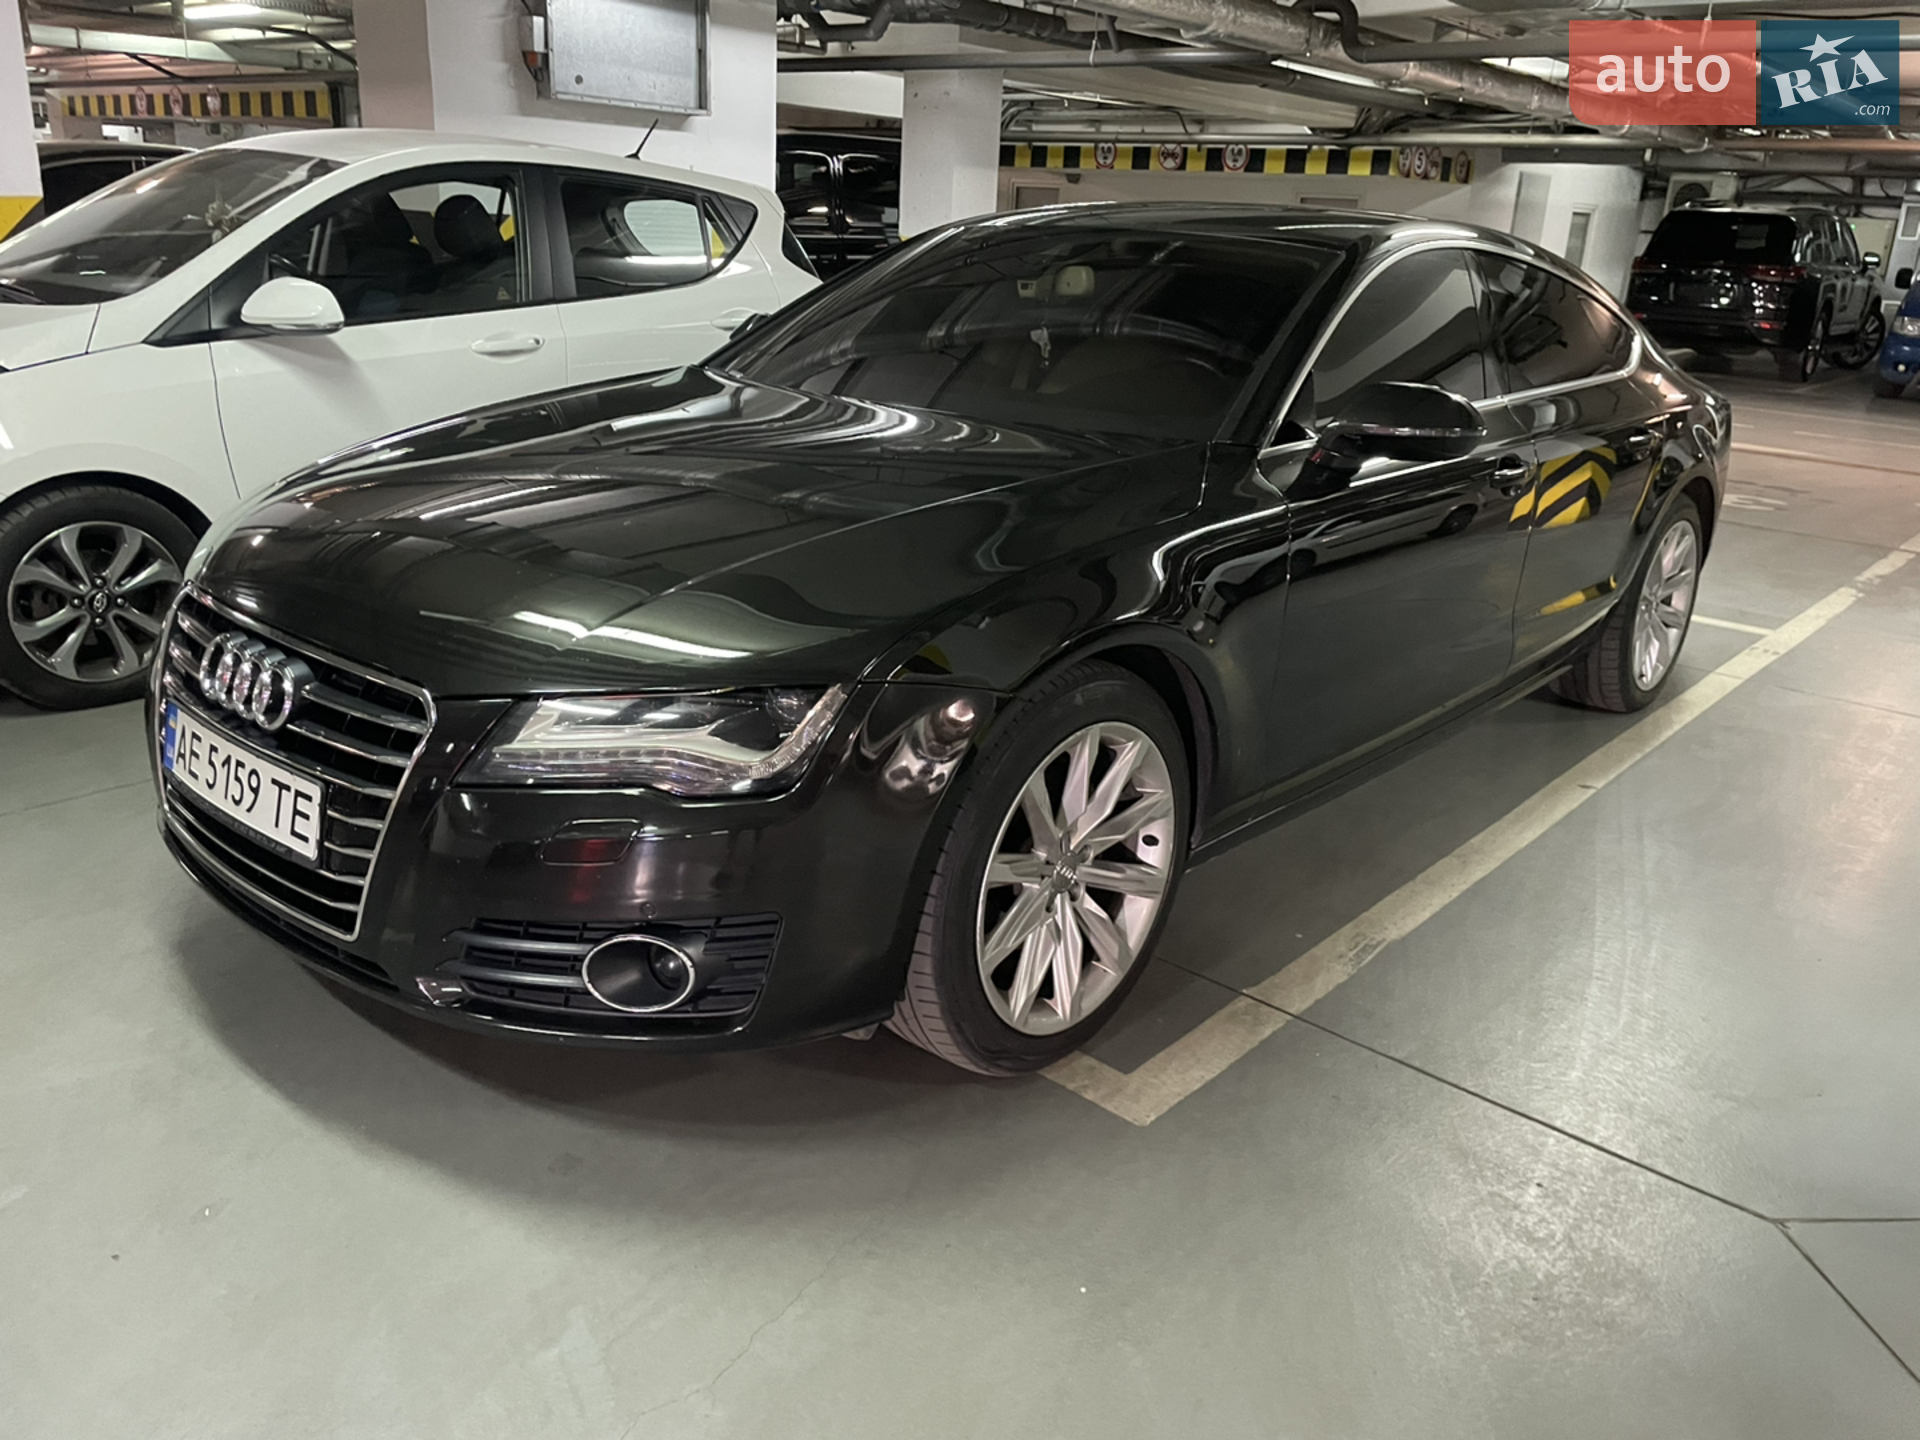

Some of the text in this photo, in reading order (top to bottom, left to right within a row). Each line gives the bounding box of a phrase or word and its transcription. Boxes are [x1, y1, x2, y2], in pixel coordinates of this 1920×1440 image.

[1417, 152, 1424, 170] 5
[175, 724, 203, 781] AE
[206, 744, 261, 813] 5159
[271, 778, 314, 844] TE
